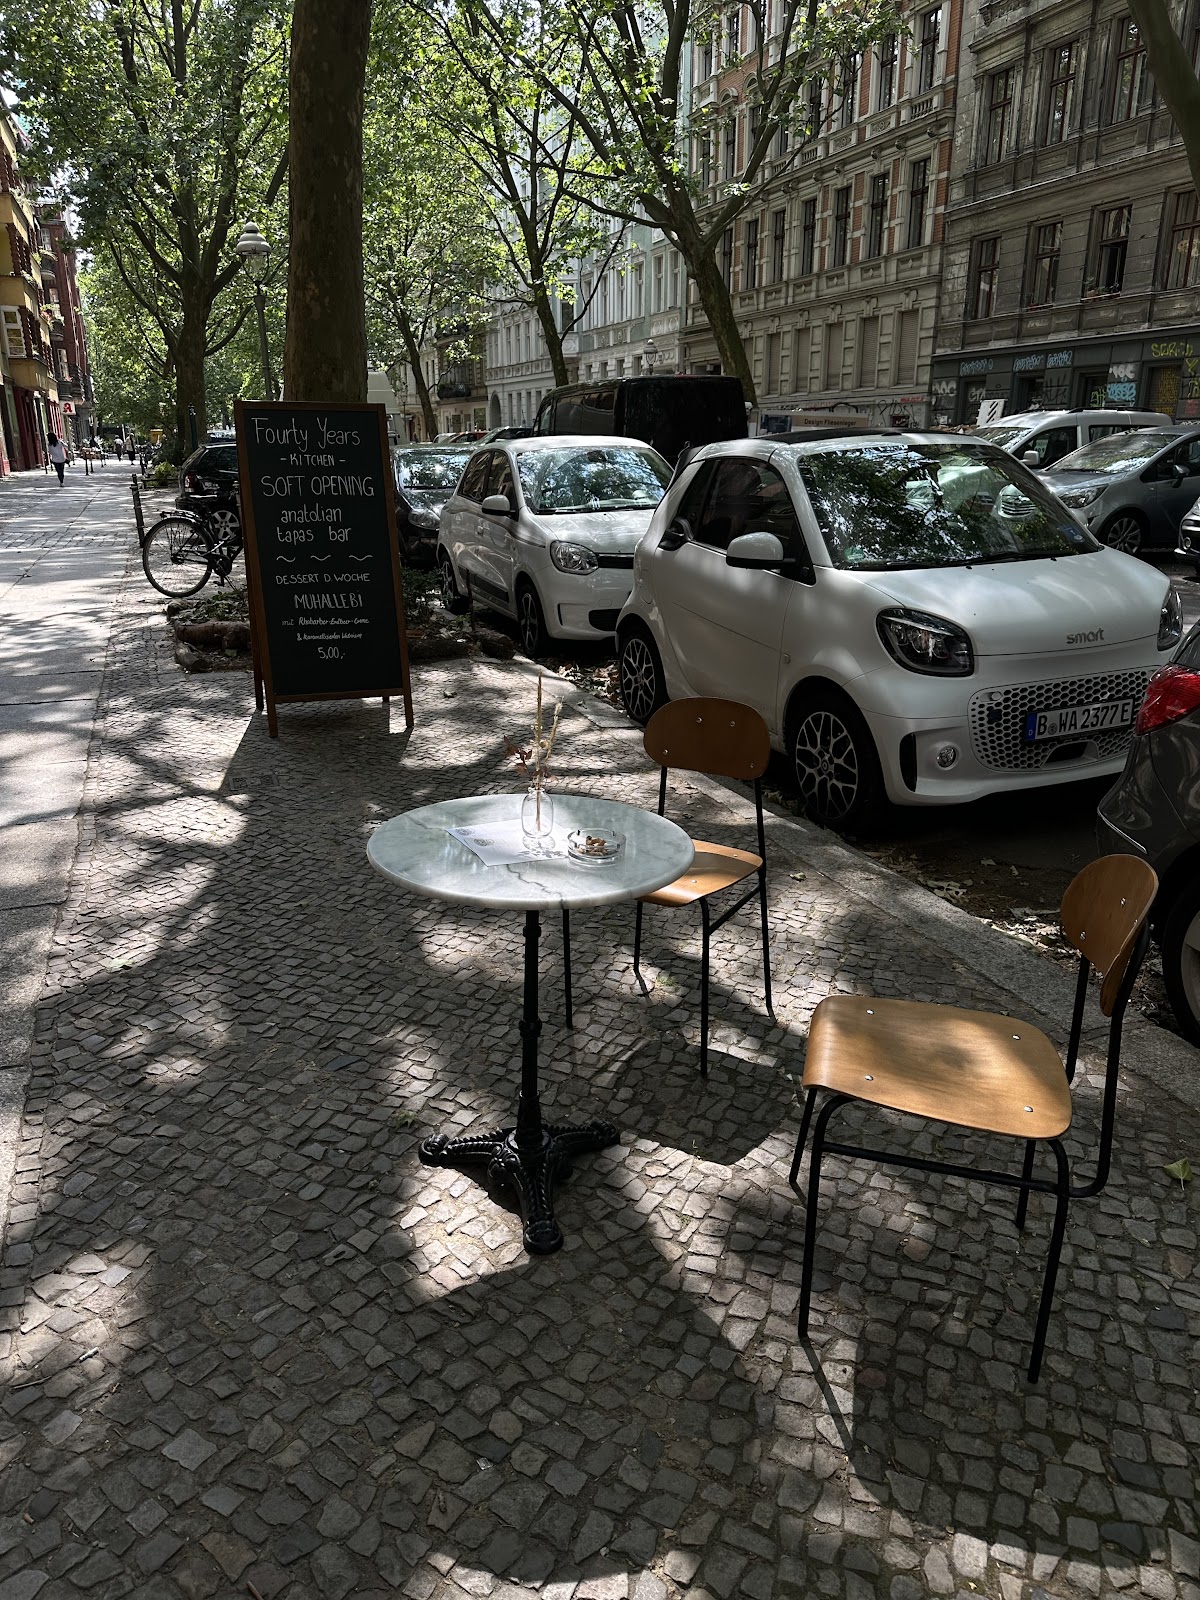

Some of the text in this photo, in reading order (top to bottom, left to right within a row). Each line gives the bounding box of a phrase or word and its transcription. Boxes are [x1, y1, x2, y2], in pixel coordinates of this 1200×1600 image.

[251, 417, 361, 452] Fourty Years
[290, 453, 335, 466] KITCHEN
[261, 475, 375, 497] SOFT OPENING
[281, 503, 342, 523] anatolian
[277, 526, 351, 546] tapas bar
[275, 573, 319, 584] DESSERT
[333, 573, 371, 582] WOCHE
[1066, 628, 1105, 644] smart
[1037, 714, 1048, 736] B
[1059, 710, 1078, 732] WA
